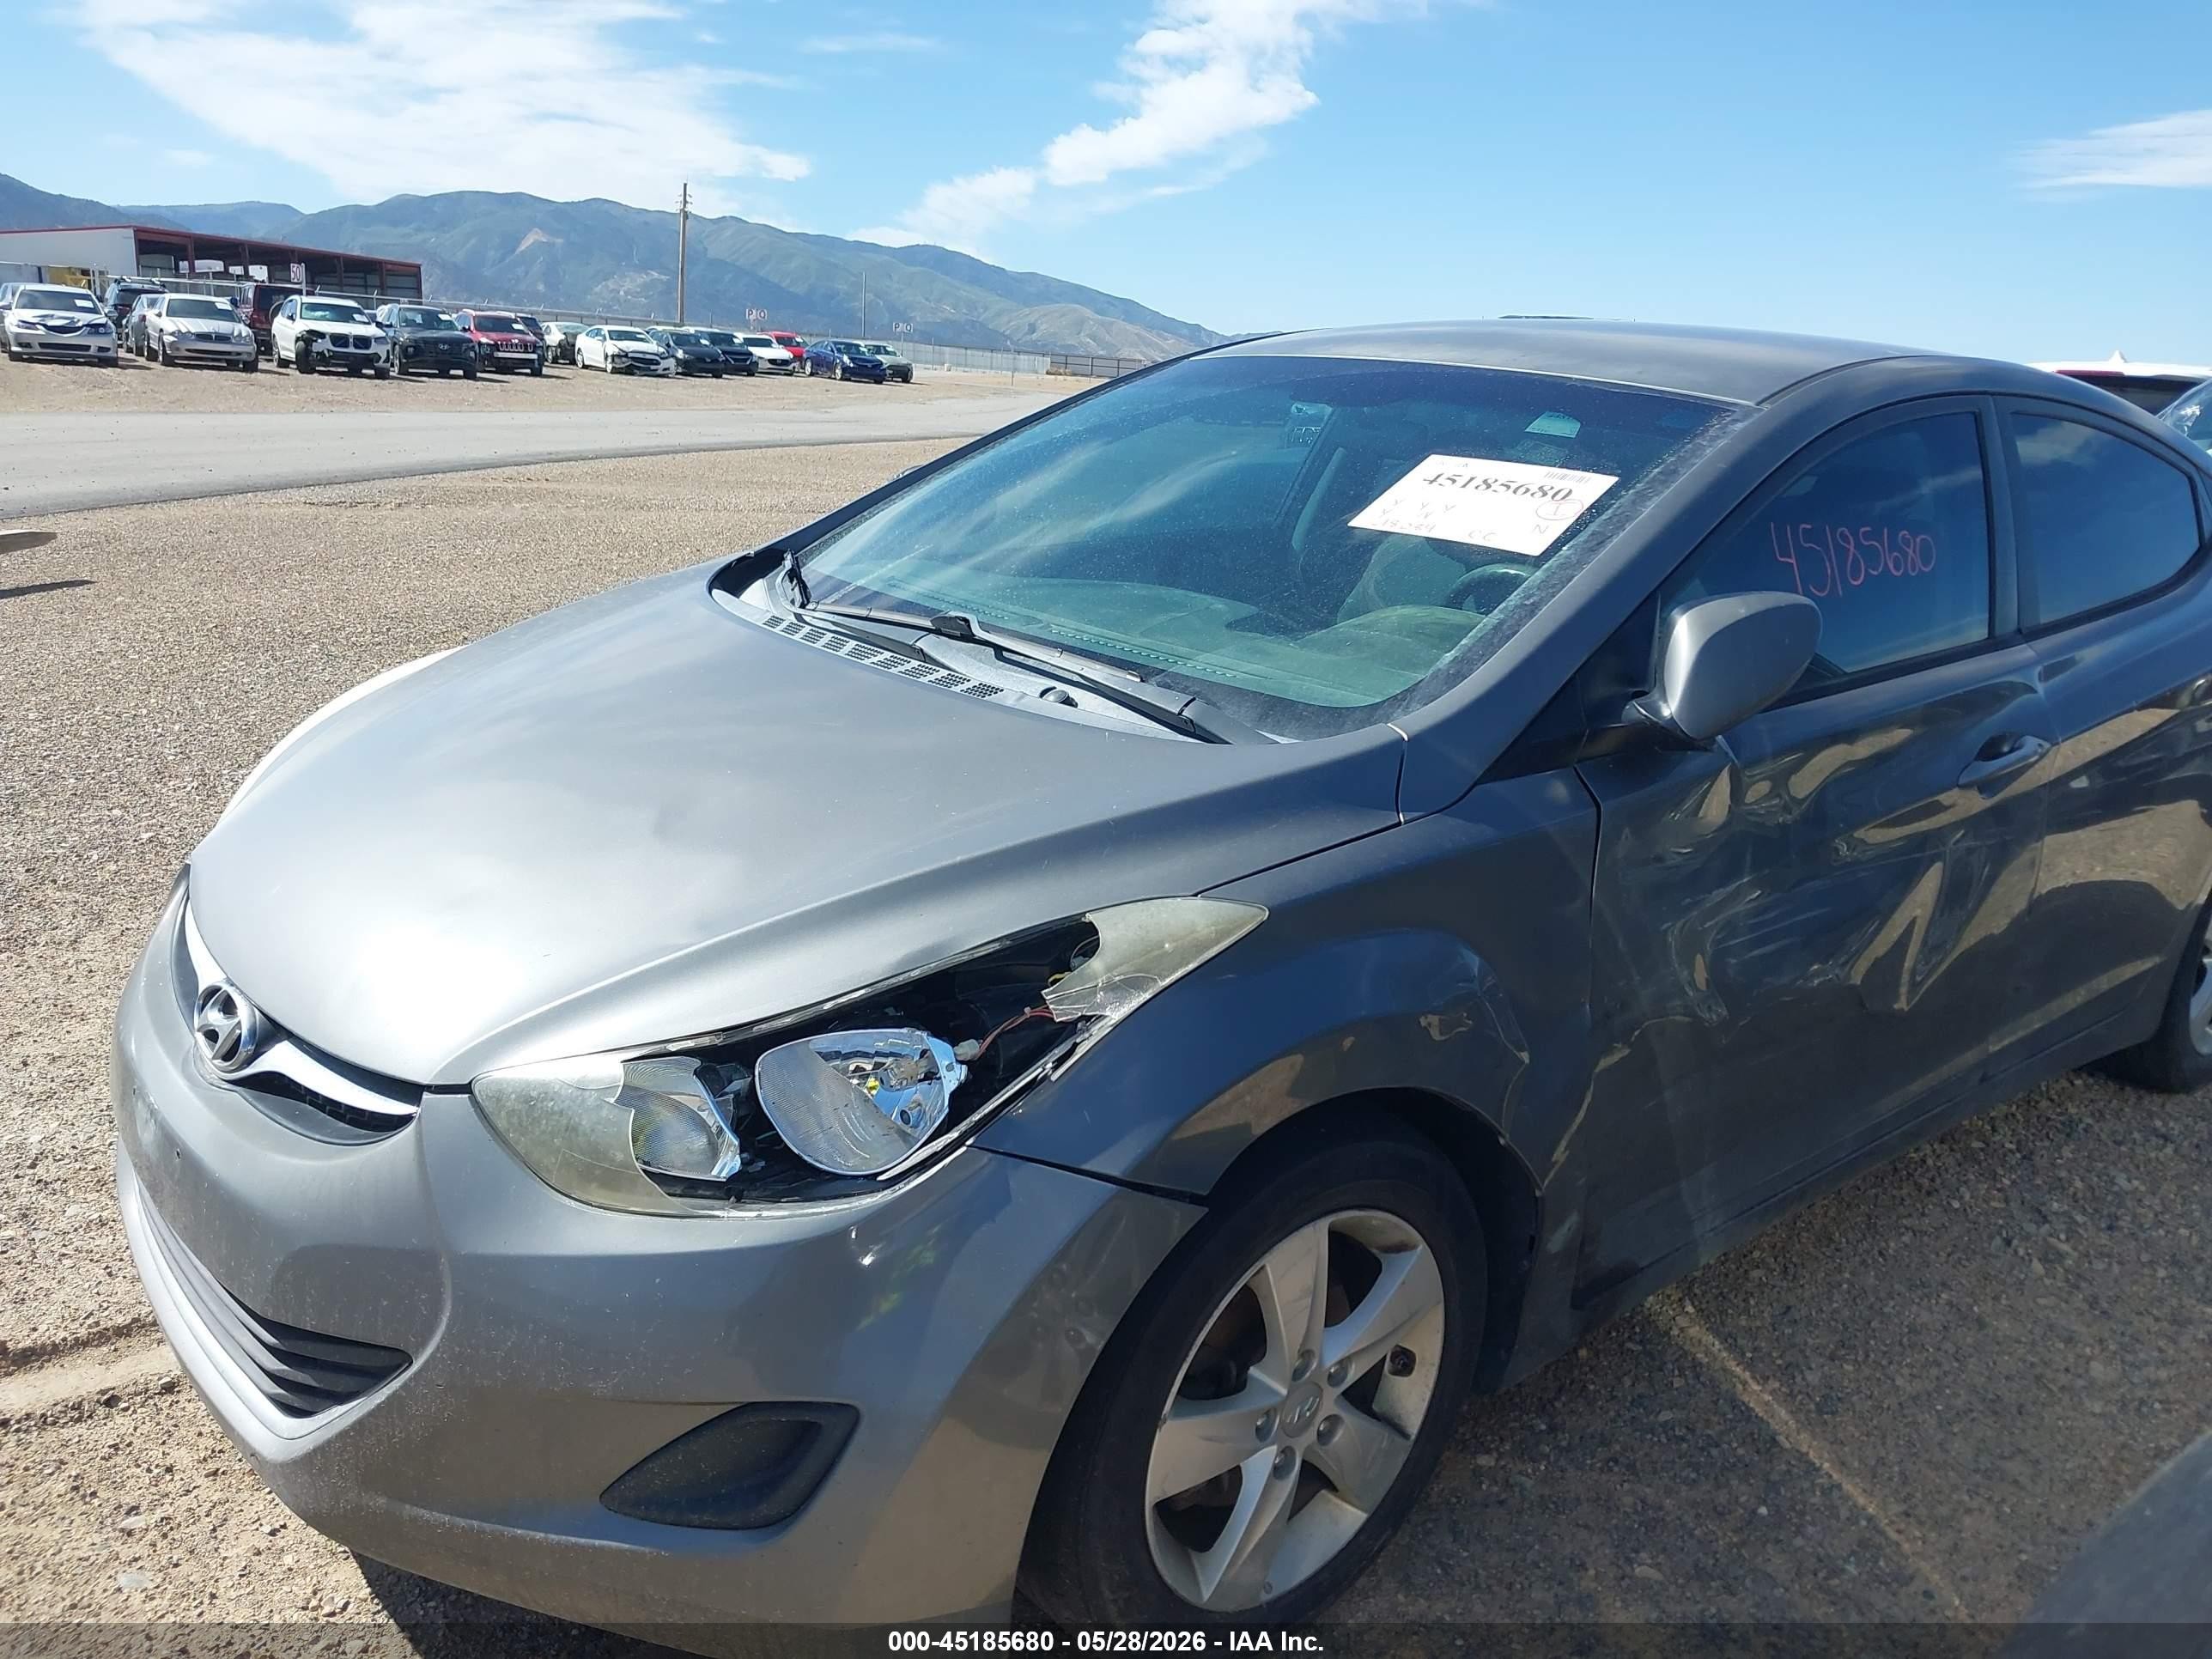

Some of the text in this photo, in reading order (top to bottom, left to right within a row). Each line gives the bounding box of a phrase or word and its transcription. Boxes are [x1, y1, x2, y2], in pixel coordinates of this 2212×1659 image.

[292, 265, 301, 282] 50
[1422, 472, 1573, 501] 45185680
[1771, 522, 1936, 597] 45185680
